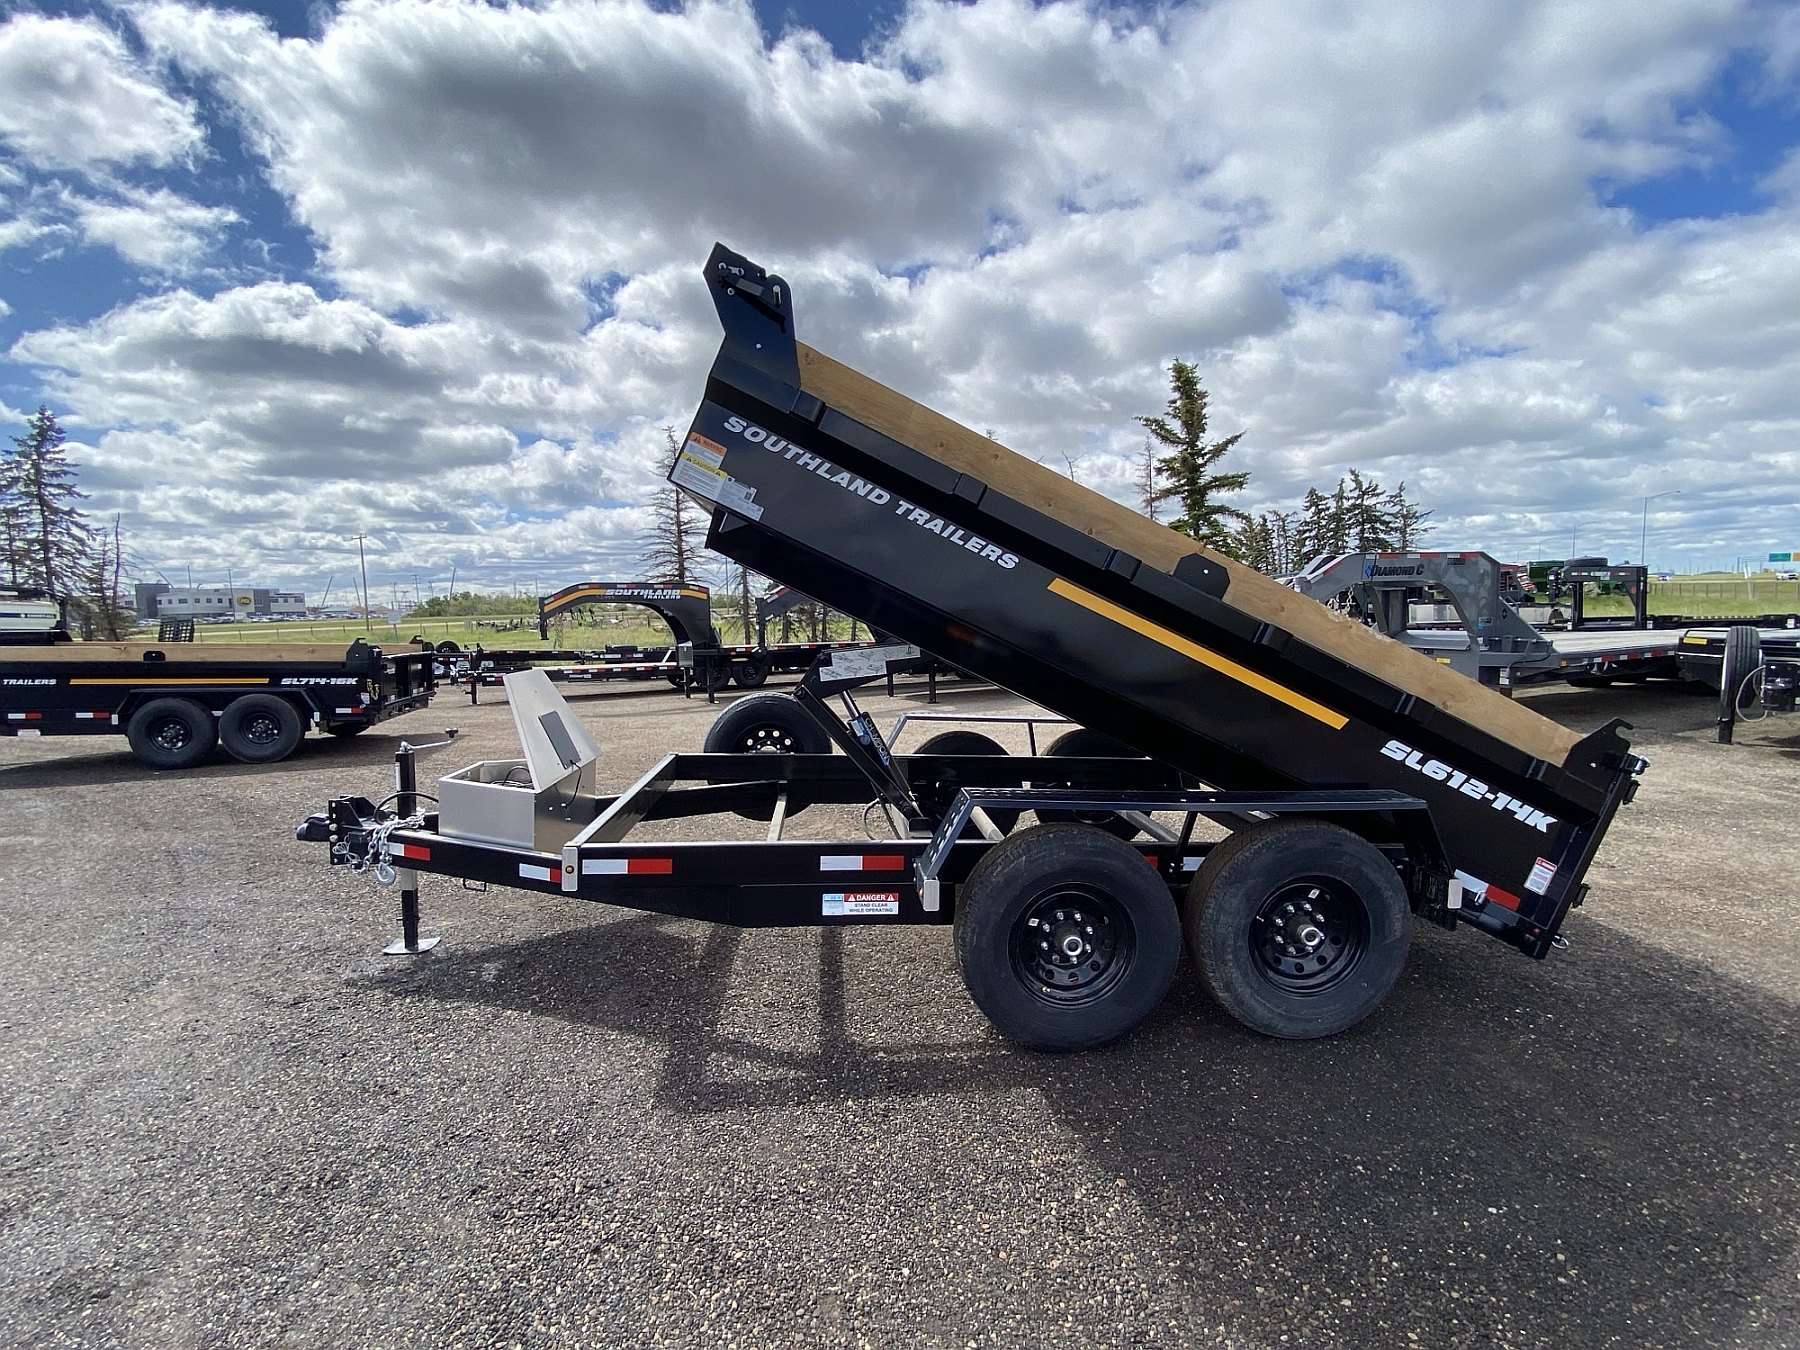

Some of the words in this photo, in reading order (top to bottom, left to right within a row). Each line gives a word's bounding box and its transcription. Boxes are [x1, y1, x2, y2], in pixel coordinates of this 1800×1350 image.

[723, 416, 890, 505] SOUTHLAND
[895, 500, 1020, 569] TRAILERS
[1416, 564, 1425, 576] C
[1379, 739, 1558, 833] SL612-14K
[856, 894, 887, 902] DANGER
